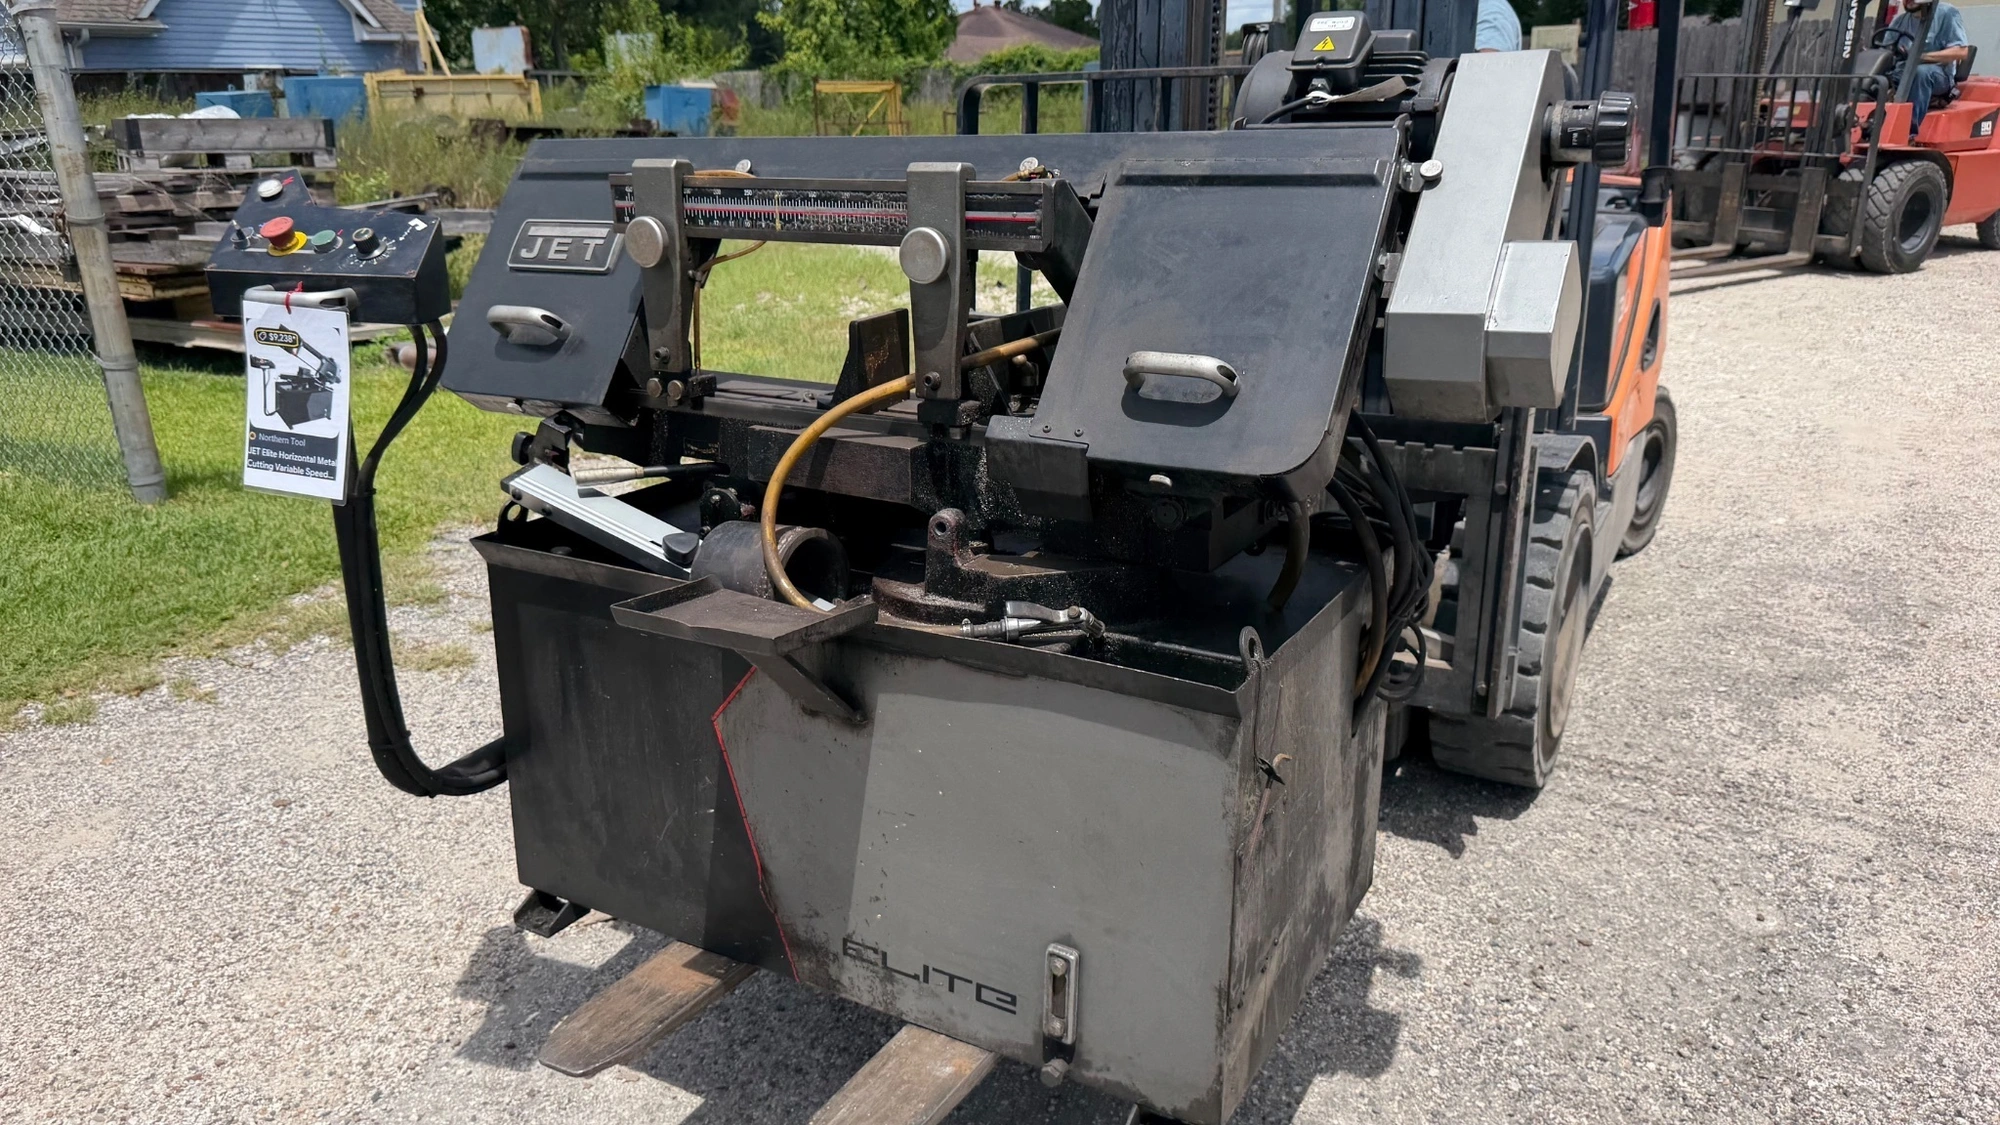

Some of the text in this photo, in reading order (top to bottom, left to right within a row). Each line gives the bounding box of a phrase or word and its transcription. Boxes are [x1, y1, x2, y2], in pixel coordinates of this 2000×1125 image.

[1843, 0, 1858, 59] NISSAN
[520, 237, 605, 261] JET
[258, 433, 306, 447] Northern Tool
[248, 446, 261, 455] JET
[261, 448, 278, 458] Elite
[278, 450, 316, 464] Horizontal
[247, 459, 274, 472] Cutting
[275, 463, 305, 475] Variable
[842, 937, 1017, 1015] ELITE
